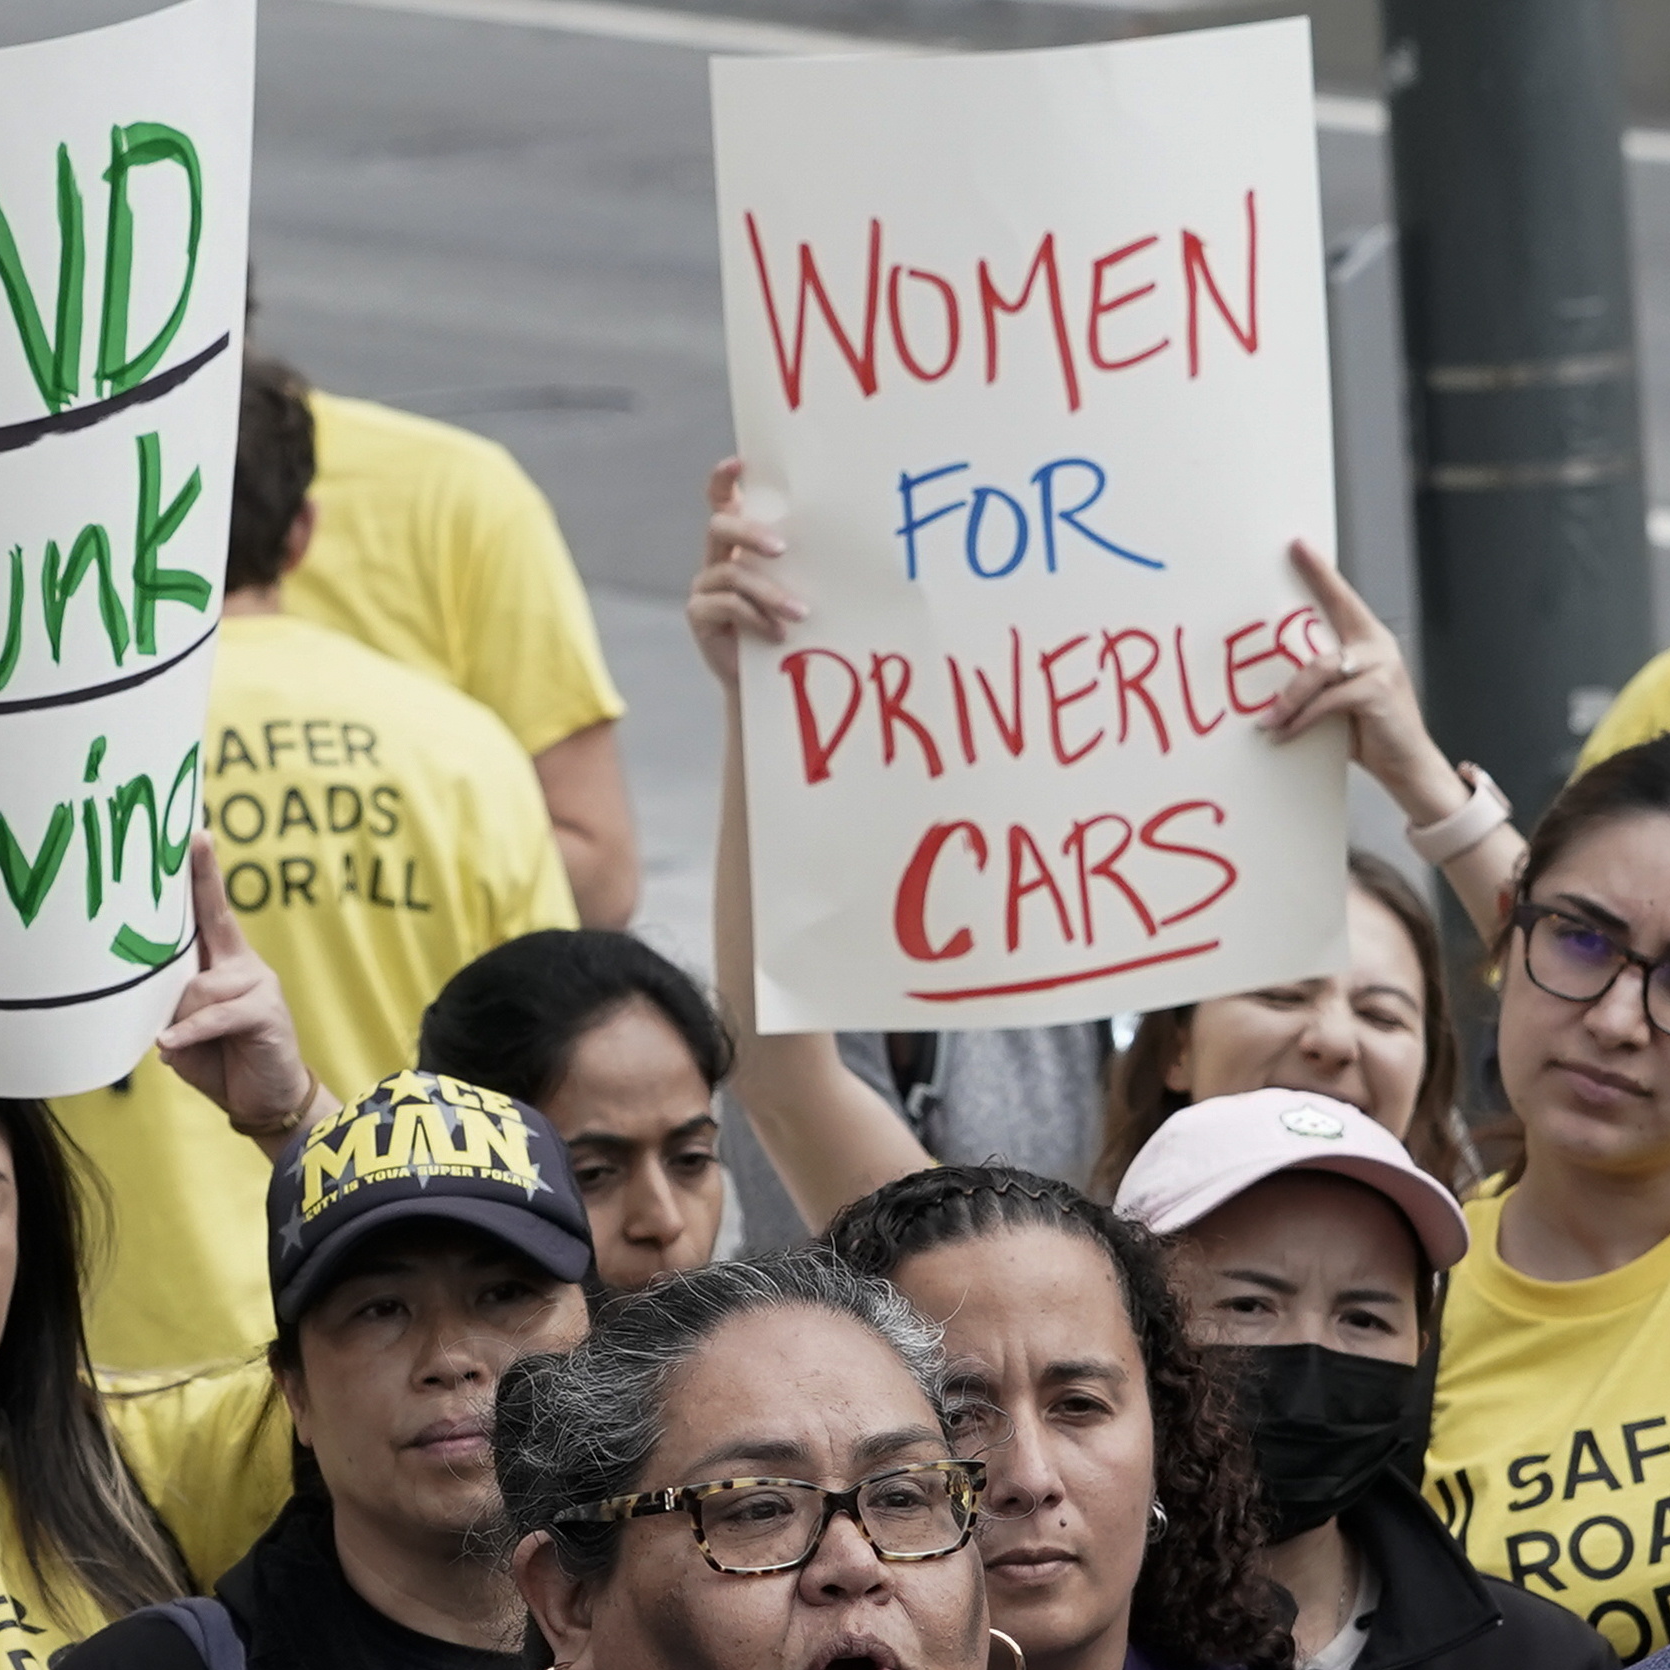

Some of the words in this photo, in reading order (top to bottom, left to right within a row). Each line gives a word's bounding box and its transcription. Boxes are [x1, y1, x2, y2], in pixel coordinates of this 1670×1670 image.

[745, 190, 1260, 413] WOMEN
[895, 457, 1166, 581] FOR
[205, 720, 380, 775] AFER
[205, 784, 400, 844] OADS
[227, 858, 316, 913] OR
[892, 799, 1239, 962] CARS
[301, 1103, 538, 1214] MAN
